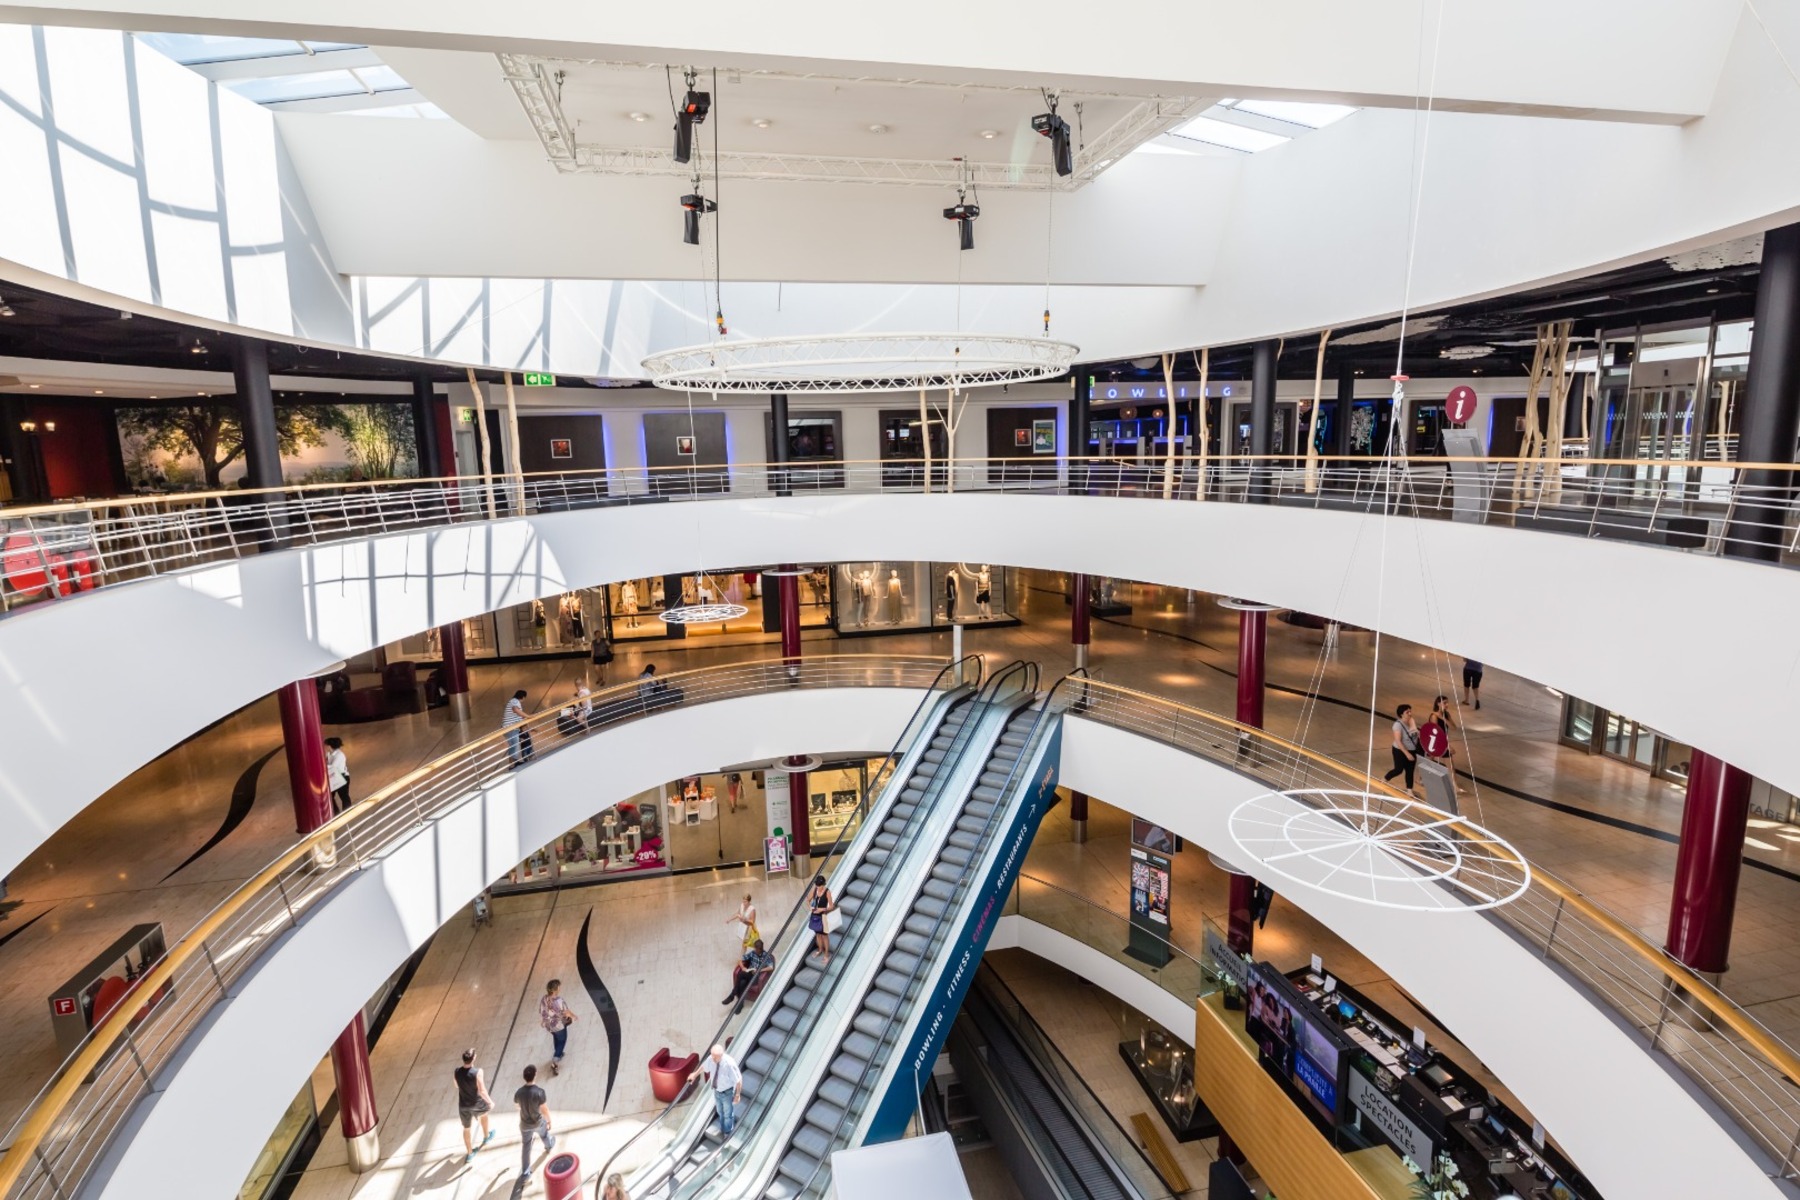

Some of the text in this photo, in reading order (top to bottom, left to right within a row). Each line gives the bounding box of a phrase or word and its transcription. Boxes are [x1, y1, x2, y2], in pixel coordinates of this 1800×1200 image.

[1090, 387, 1231, 399] OWLIG
[914, 1011, 943, 1070] BOWLING
[947, 950, 970, 999] FITNESS
[997, 823, 1028, 889] RESTAURANTS
[1218, 944, 1243, 972] ACCUEIL
[60, 1000, 71, 1012] F
[1360, 1094, 1416, 1155] SPECTACLES
[1365, 1085, 1413, 1139] LOCATION
